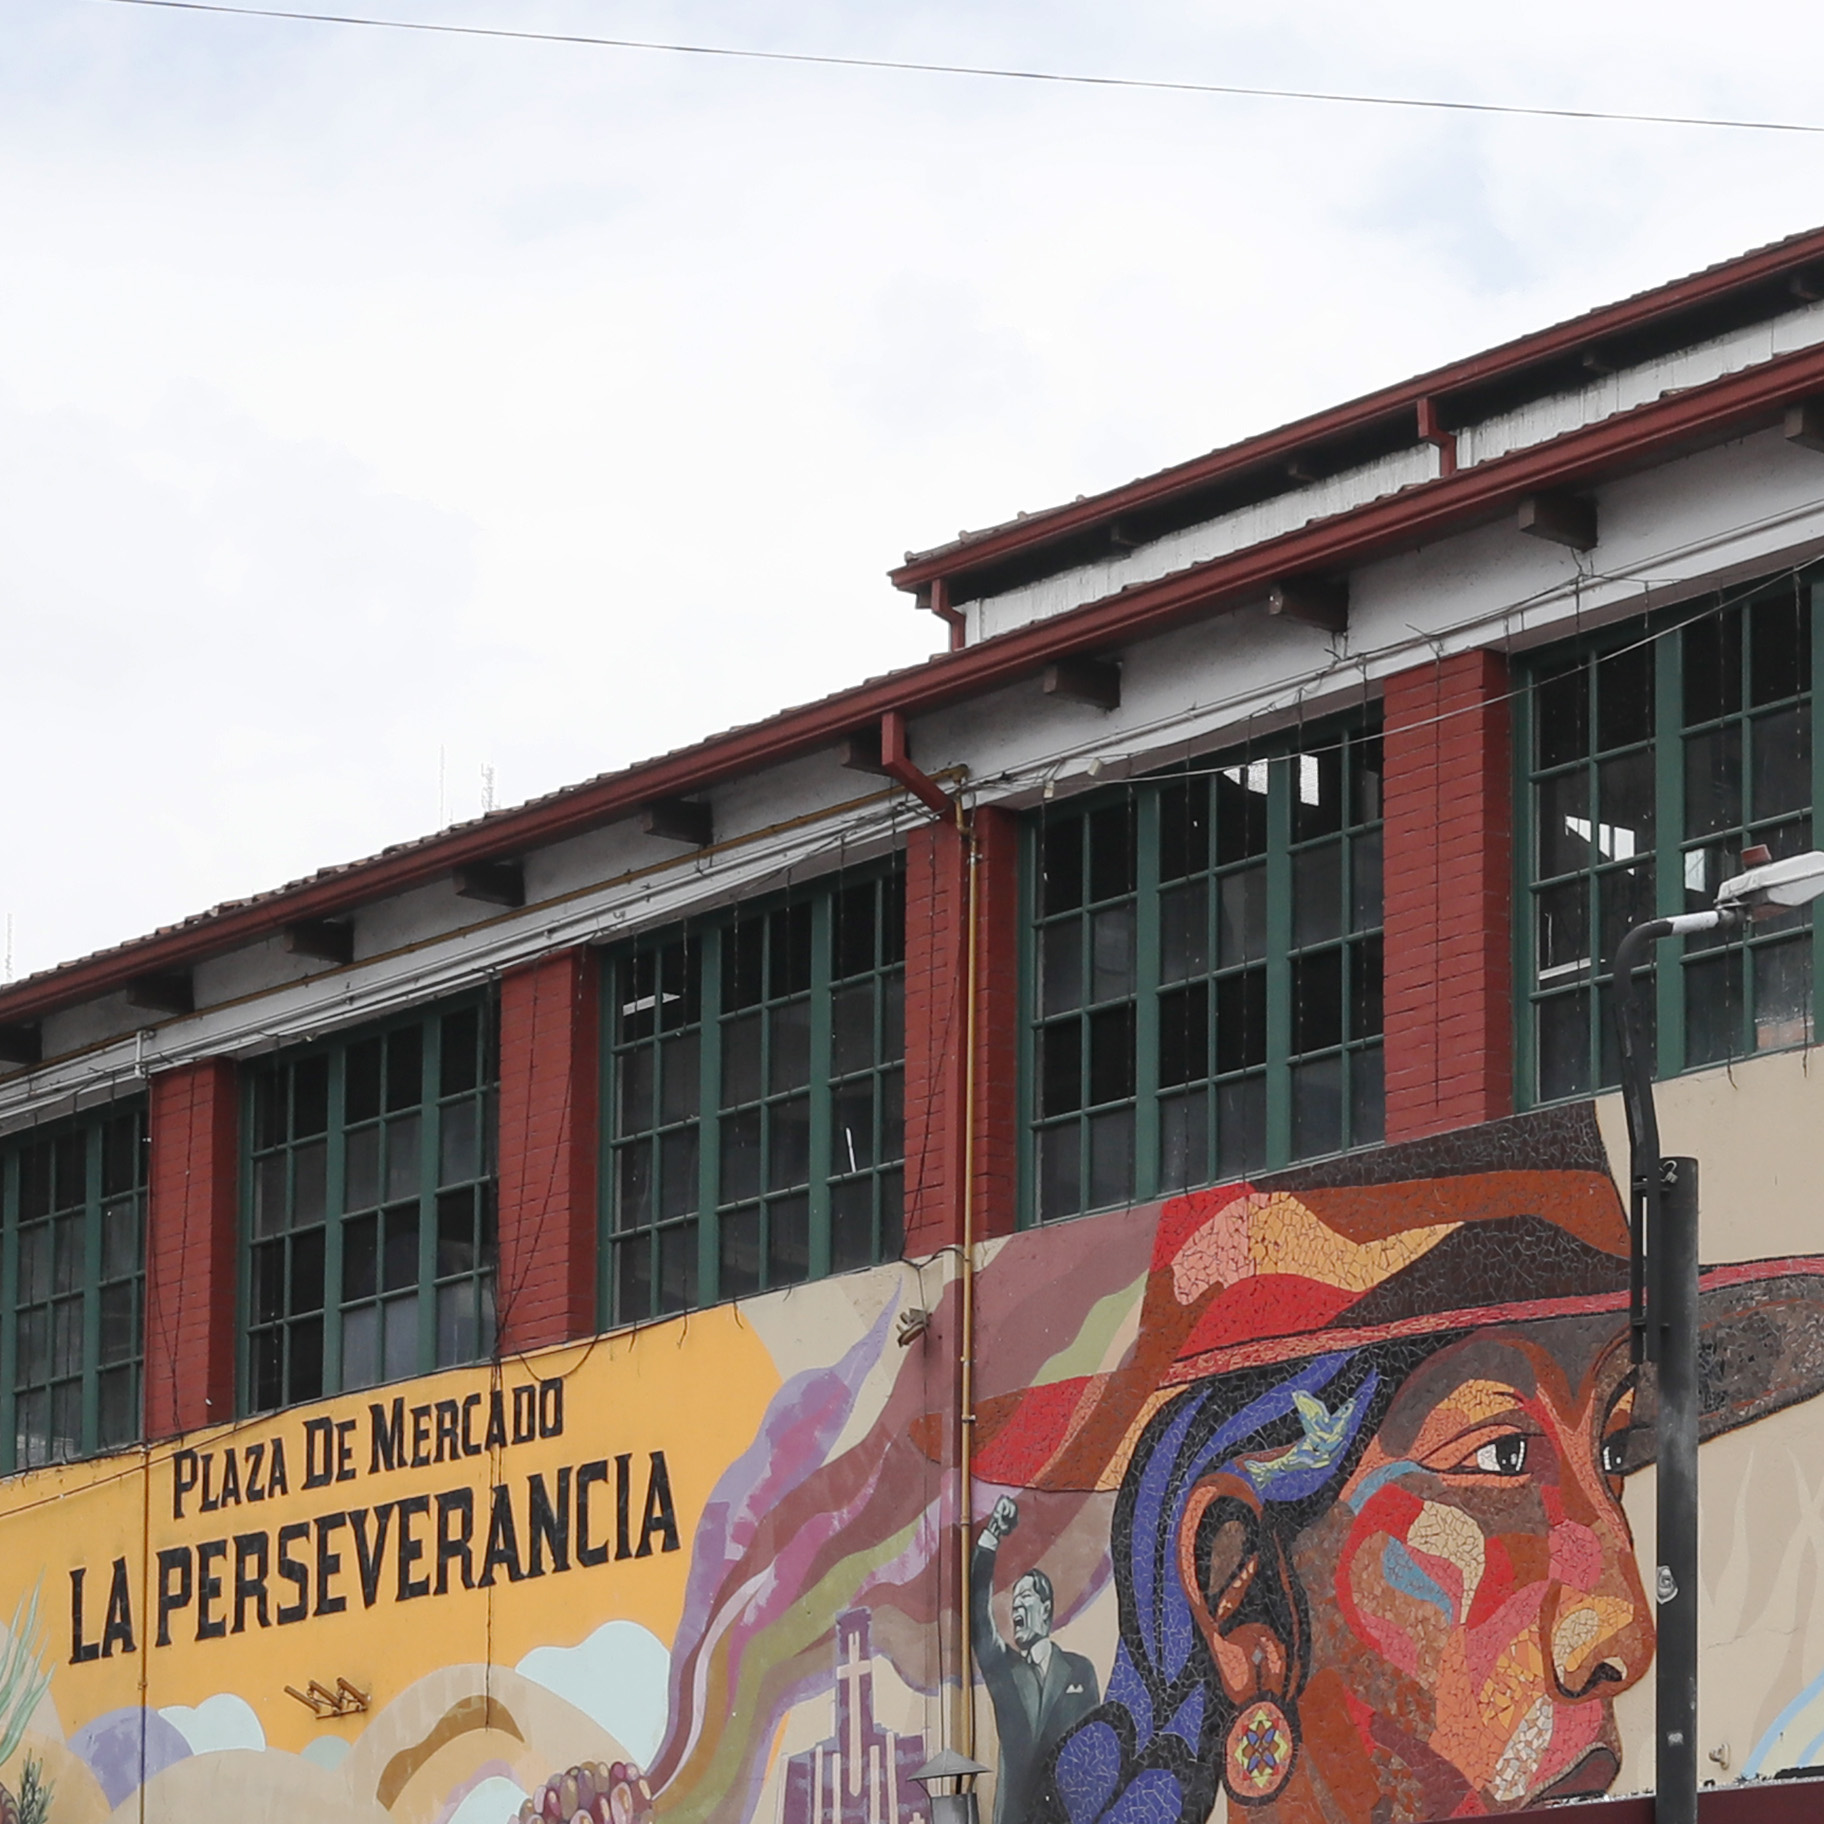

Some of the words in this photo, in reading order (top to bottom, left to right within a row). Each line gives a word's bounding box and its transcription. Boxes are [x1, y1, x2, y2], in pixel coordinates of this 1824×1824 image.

[172, 1437, 288, 1519] PLAZA
[301, 1416, 357, 1490] DE
[368, 1376, 564, 1474] MERCADO
[69, 1556, 137, 1665] LA
[155, 1450, 680, 1648] PERSEVERANCIA
